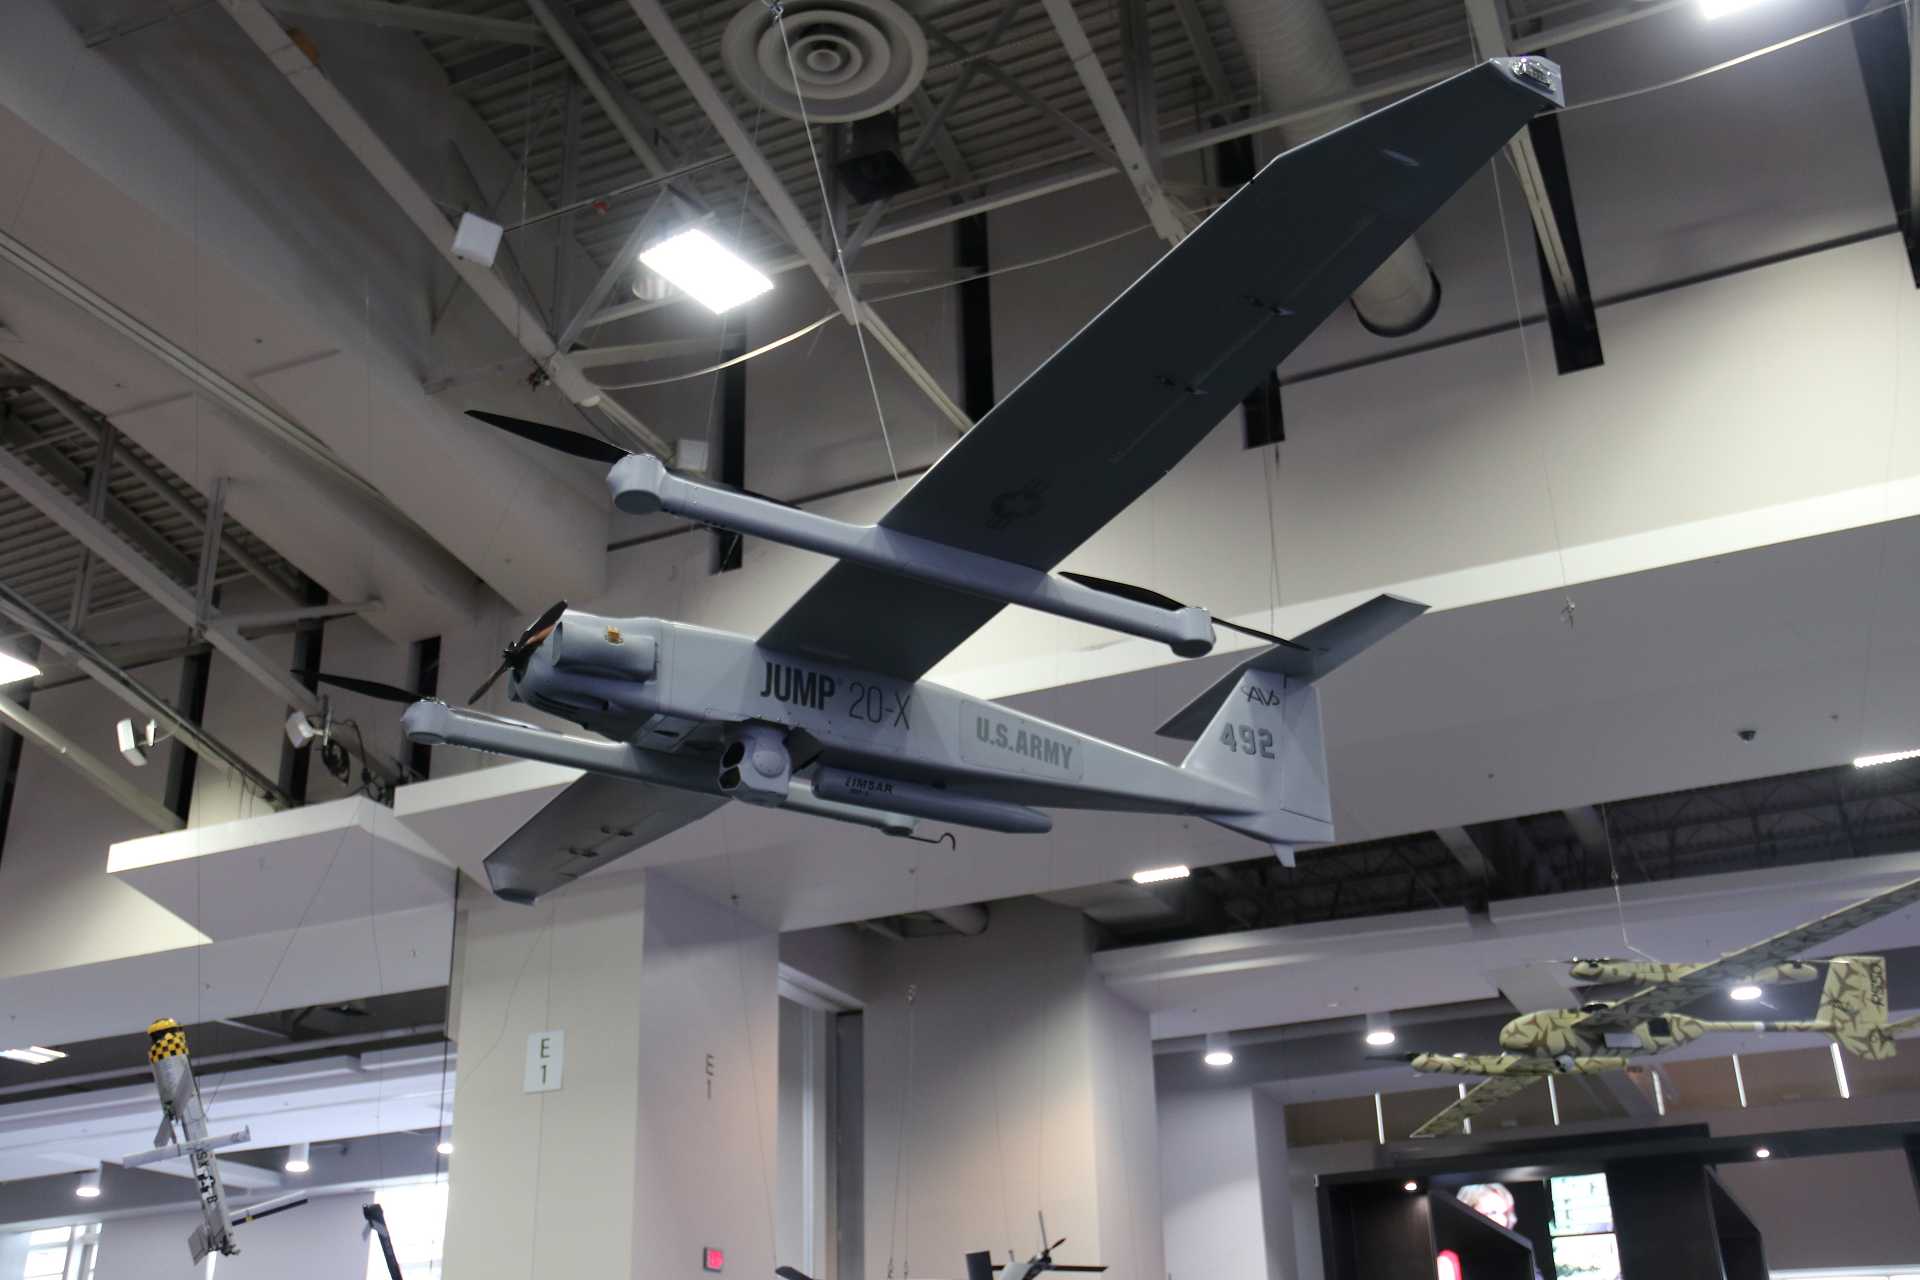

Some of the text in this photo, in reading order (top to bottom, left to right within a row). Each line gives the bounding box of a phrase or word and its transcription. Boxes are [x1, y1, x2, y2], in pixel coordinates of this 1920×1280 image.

[761, 661, 911, 731] JUMP 20-X
[1220, 722, 1275, 760] 492
[540, 1038, 551, 1059] E
[541, 1065, 547, 1085] 1
